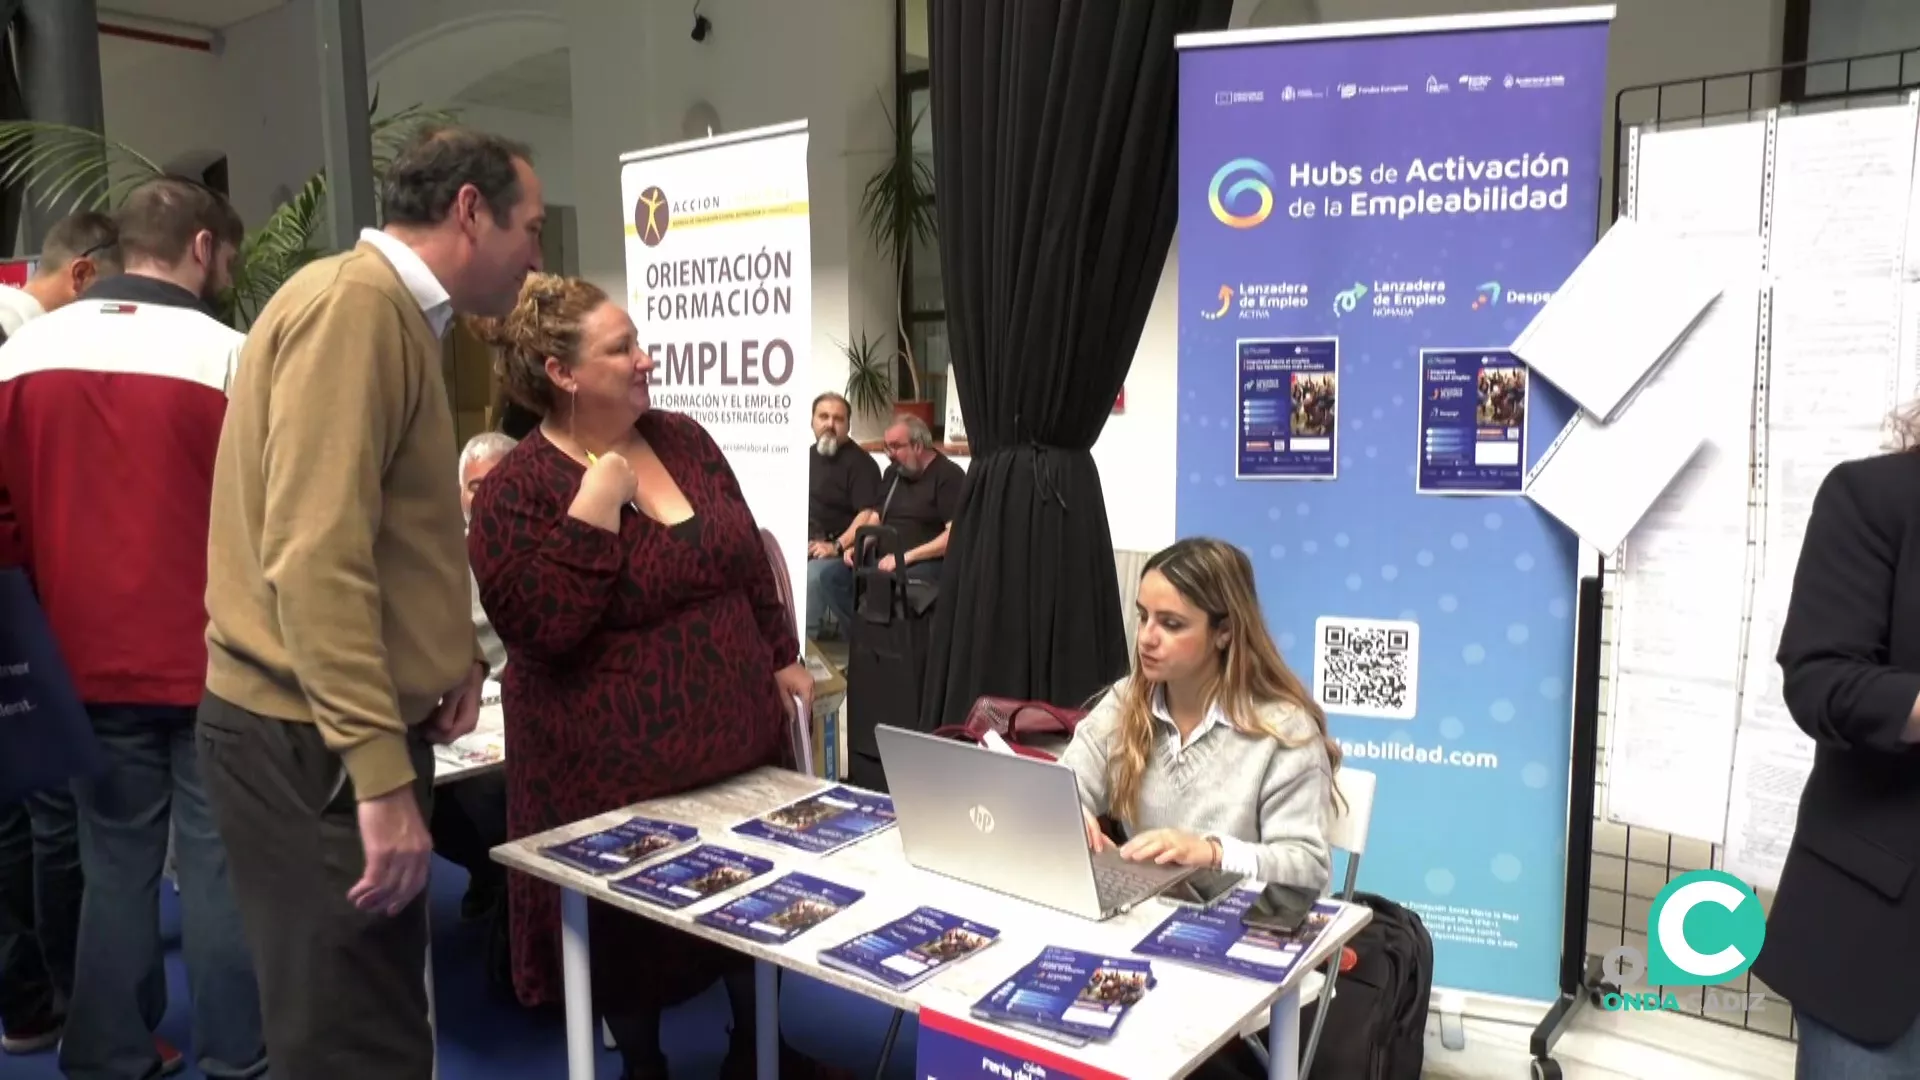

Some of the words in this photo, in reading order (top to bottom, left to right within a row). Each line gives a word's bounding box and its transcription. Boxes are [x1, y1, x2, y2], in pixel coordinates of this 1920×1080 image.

[1289, 161, 1363, 188] Hubs
[1370, 162, 1398, 185] de
[1405, 152, 1569, 183] Activación
[1288, 196, 1316, 218] de
[1324, 196, 1343, 217] la
[1350, 182, 1568, 220] Empleabilidad
[646, 245, 792, 290] ORIENTACIÓN
[1239, 281, 1308, 295] Lanzadera
[1374, 277, 1446, 292] Lanzadera
[1506, 290, 1552, 305] Despe
[646, 281, 792, 321] FORMACIÓN
[1239, 293, 1255, 308] de
[1259, 295, 1309, 311] Empleo
[1373, 292, 1390, 306] de
[1394, 292, 1446, 308] Empleo
[647, 337, 795, 387] EMPLEO
[660, 392, 720, 409] FORMACIÓN
[722, 394, 728, 408] Y
[731, 394, 742, 408] EL
[744, 394, 792, 409] EMPLEO
[1336, 737, 1498, 768] leabilidad.com
[969, 804, 995, 834] hp
